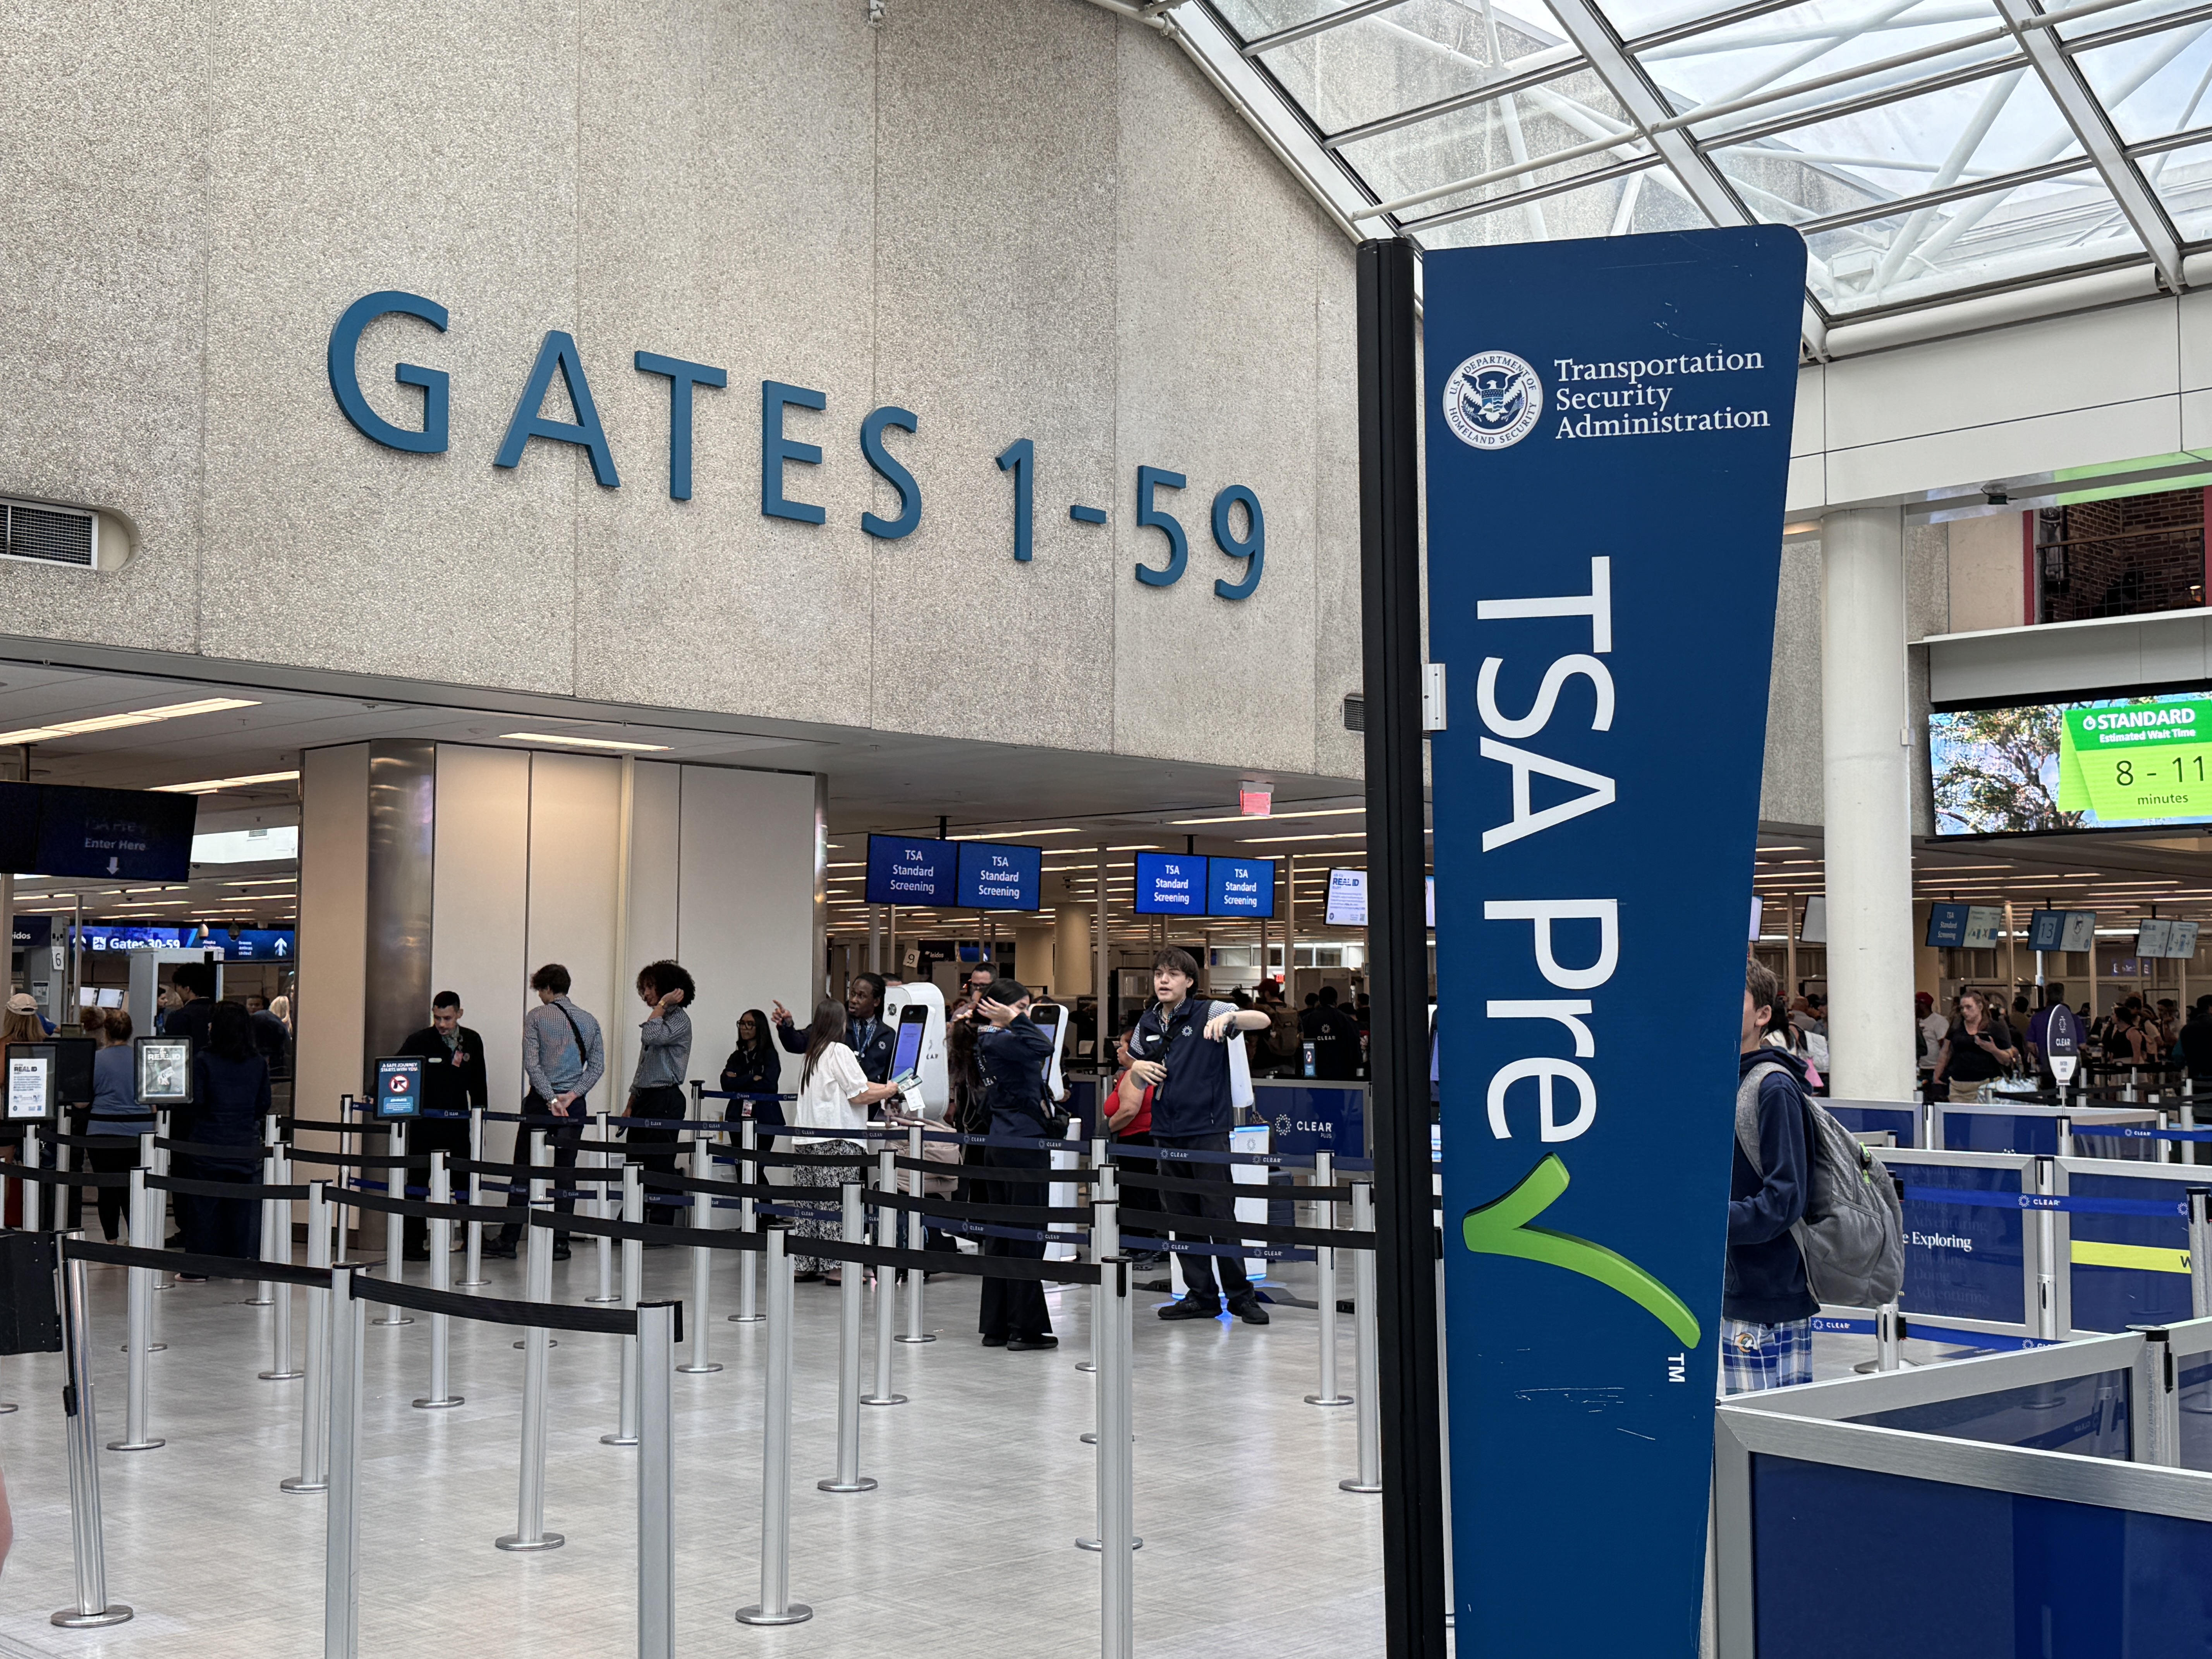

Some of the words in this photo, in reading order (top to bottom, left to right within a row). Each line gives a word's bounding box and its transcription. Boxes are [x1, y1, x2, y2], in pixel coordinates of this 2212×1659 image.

[1554, 349, 1764, 384] Transportation
[1449, 379, 1462, 395] U.S.
[1463, 356, 1530, 378] DEPARTMENT
[1526, 378, 1537, 391] OF
[1556, 385, 1673, 412] Security
[1449, 407, 1495, 444] HOMELAND
[1499, 402, 1537, 444] SECURITY
[1555, 406, 1771, 439] Administration
[328, 290, 923, 539] GATES
[995, 438, 1266, 599] 1-59
[1477, 556, 1616, 852] TSA
[2097, 708, 2195, 730] STANDARD
[2099, 731, 2146, 743] Estimated
[2147, 730, 2171, 739] Wait
[2171, 728, 2196, 737] Time
[2116, 760, 2133, 786] 8
[2172, 756, 2203, 782] 11
[2137, 793, 2188, 805] minutes
[85, 837, 117, 849] Enter
[118, 840, 146, 851] Here
[905, 850, 923, 861] TSA
[992, 856, 1009, 867] TSA
[893, 864, 934, 877] Standard
[980, 870, 1019, 882] Standard
[1165, 864, 1180, 875] TSA
[1235, 868, 1249, 878] TSA
[890, 879, 934, 895] Screening
[1156, 878, 1188, 889] Standard
[1225, 881, 1257, 892] Standard
[979, 884, 1020, 900] Screening
[1154, 891, 1189, 905] Screening
[1224, 895, 1257, 908] Screening
[12, 931, 31, 939] idos
[2042, 923, 2054, 938] 13
[110, 938, 144, 949] Gates
[55, 953, 61, 966] 6
[907, 954, 915, 964] 9
[1484, 898, 1619, 1142] Pre
[2056, 1038, 2071, 1046] CLEAR
[1297, 1121, 1332, 1132] CLEAR
[1902, 1233, 1909, 1244] e
[1912, 1231, 1972, 1252] Exploring
[1667, 1352, 1685, 1382] TM
